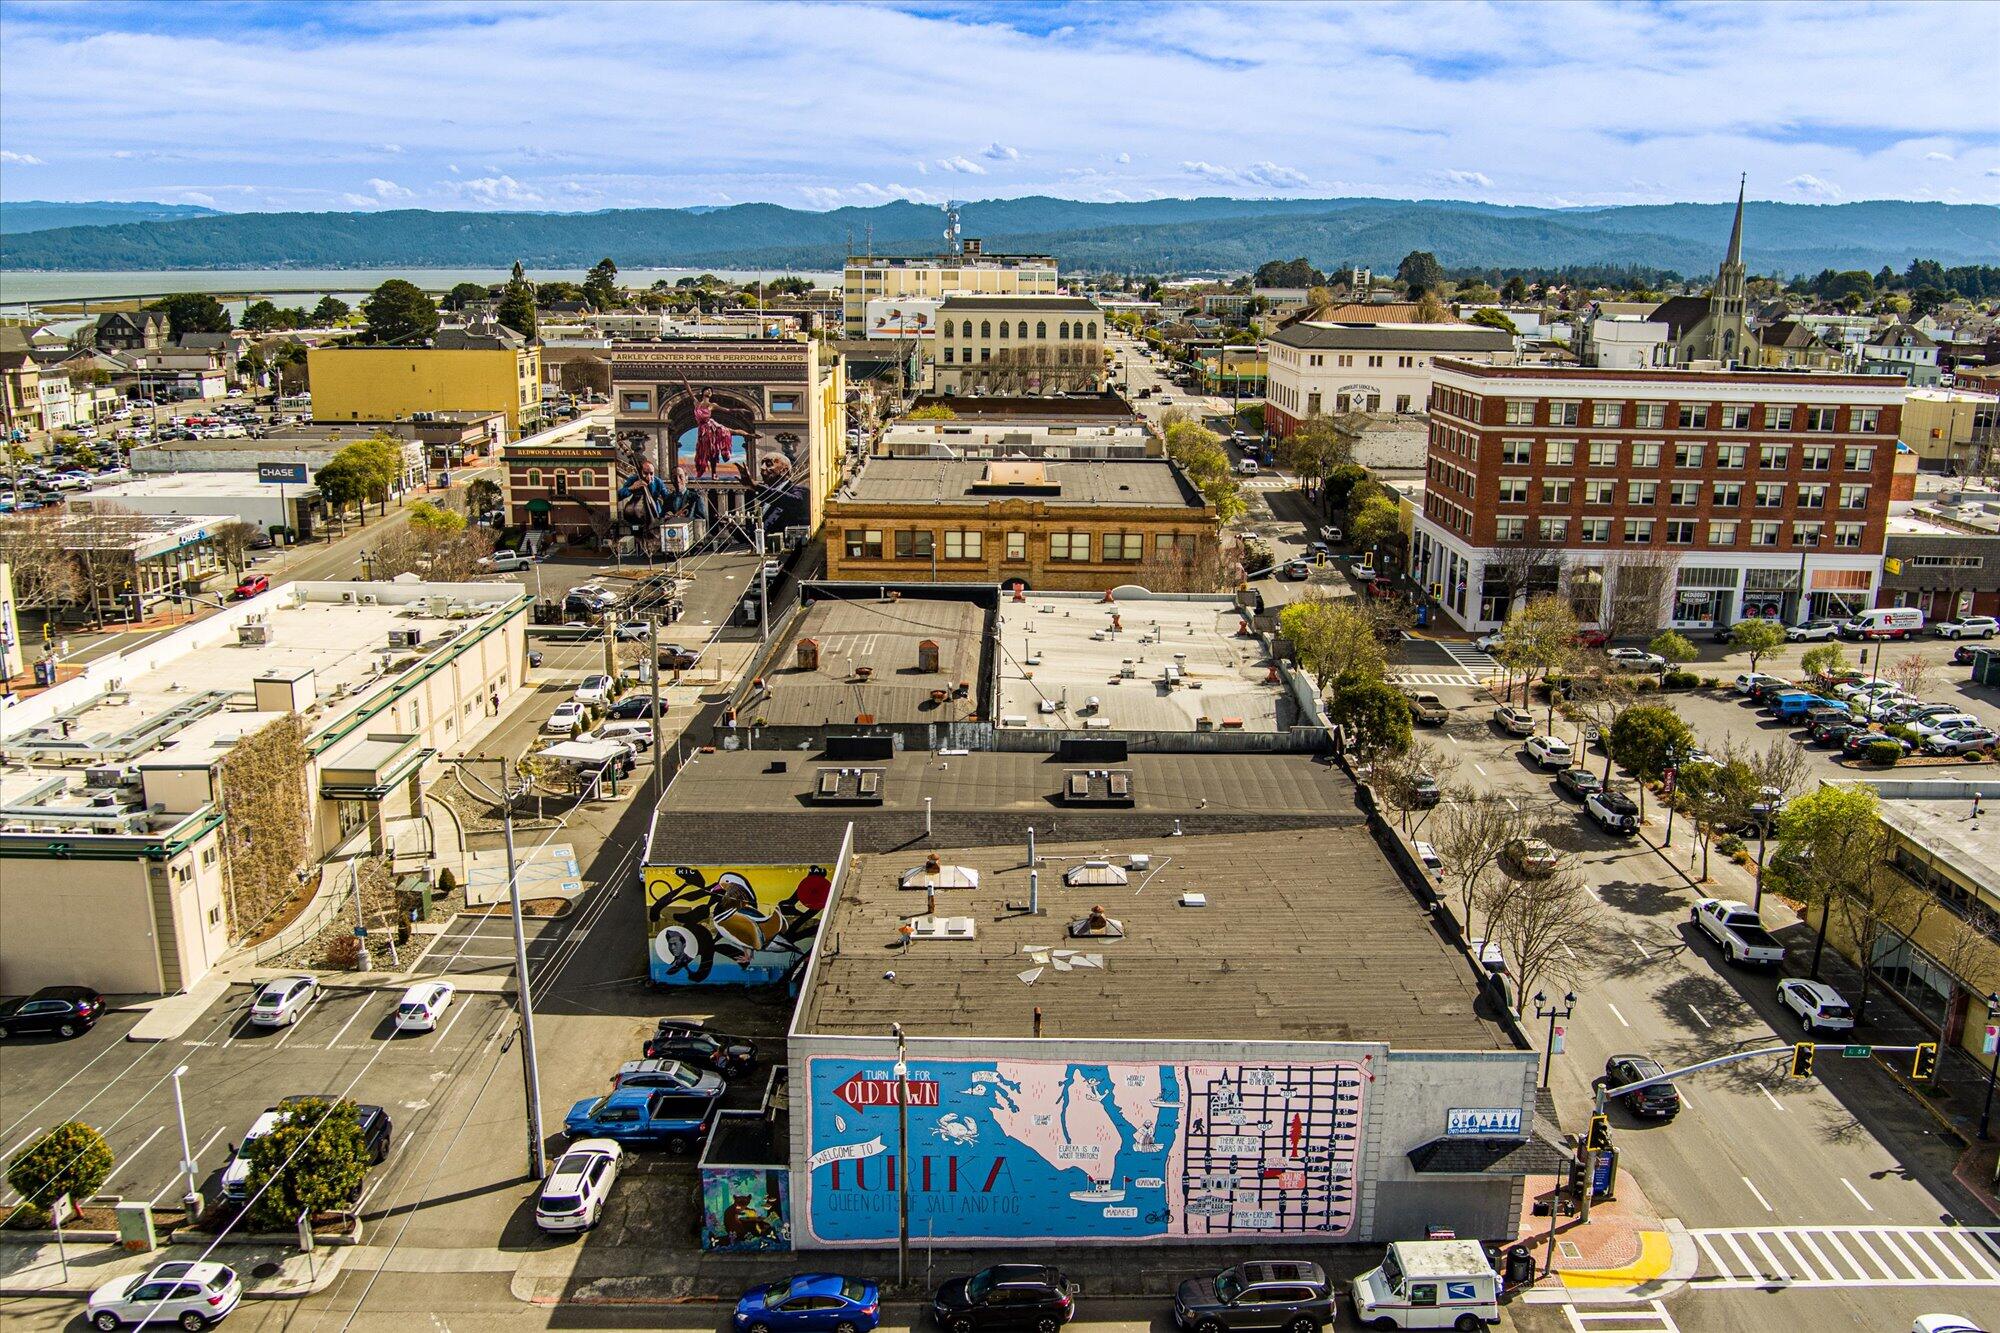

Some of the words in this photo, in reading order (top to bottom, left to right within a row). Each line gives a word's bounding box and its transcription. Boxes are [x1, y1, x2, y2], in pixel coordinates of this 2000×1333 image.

[261, 468, 295, 477] CHASE
[181, 531, 201, 544] CHASE
[1587, 731, 1597, 739] 30
[865, 1069, 889, 1080] TURN
[914, 1070, 931, 1081] FOR
[1191, 1068, 1208, 1076] TRAIL
[845, 1081, 880, 1104] OLD
[1236, 1137, 1245, 1145] ARE
[814, 1145, 855, 1165] WELCOME
[861, 1143, 874, 1157] TO
[830, 1154, 1019, 1193] EUREKA
[828, 1194, 871, 1216] QUEEN
[926, 1195, 957, 1214] SALT
[961, 1196, 990, 1214] AND
[993, 1196, 1020, 1215] FOG
[1106, 1209, 1136, 1217] MADAKET
[1235, 1211, 1249, 1219] PARK
[1253, 1211, 1274, 1219] EXPLORE
[1240, 1219, 1250, 1227] THE
[1252, 1219, 1268, 1227] CITY
